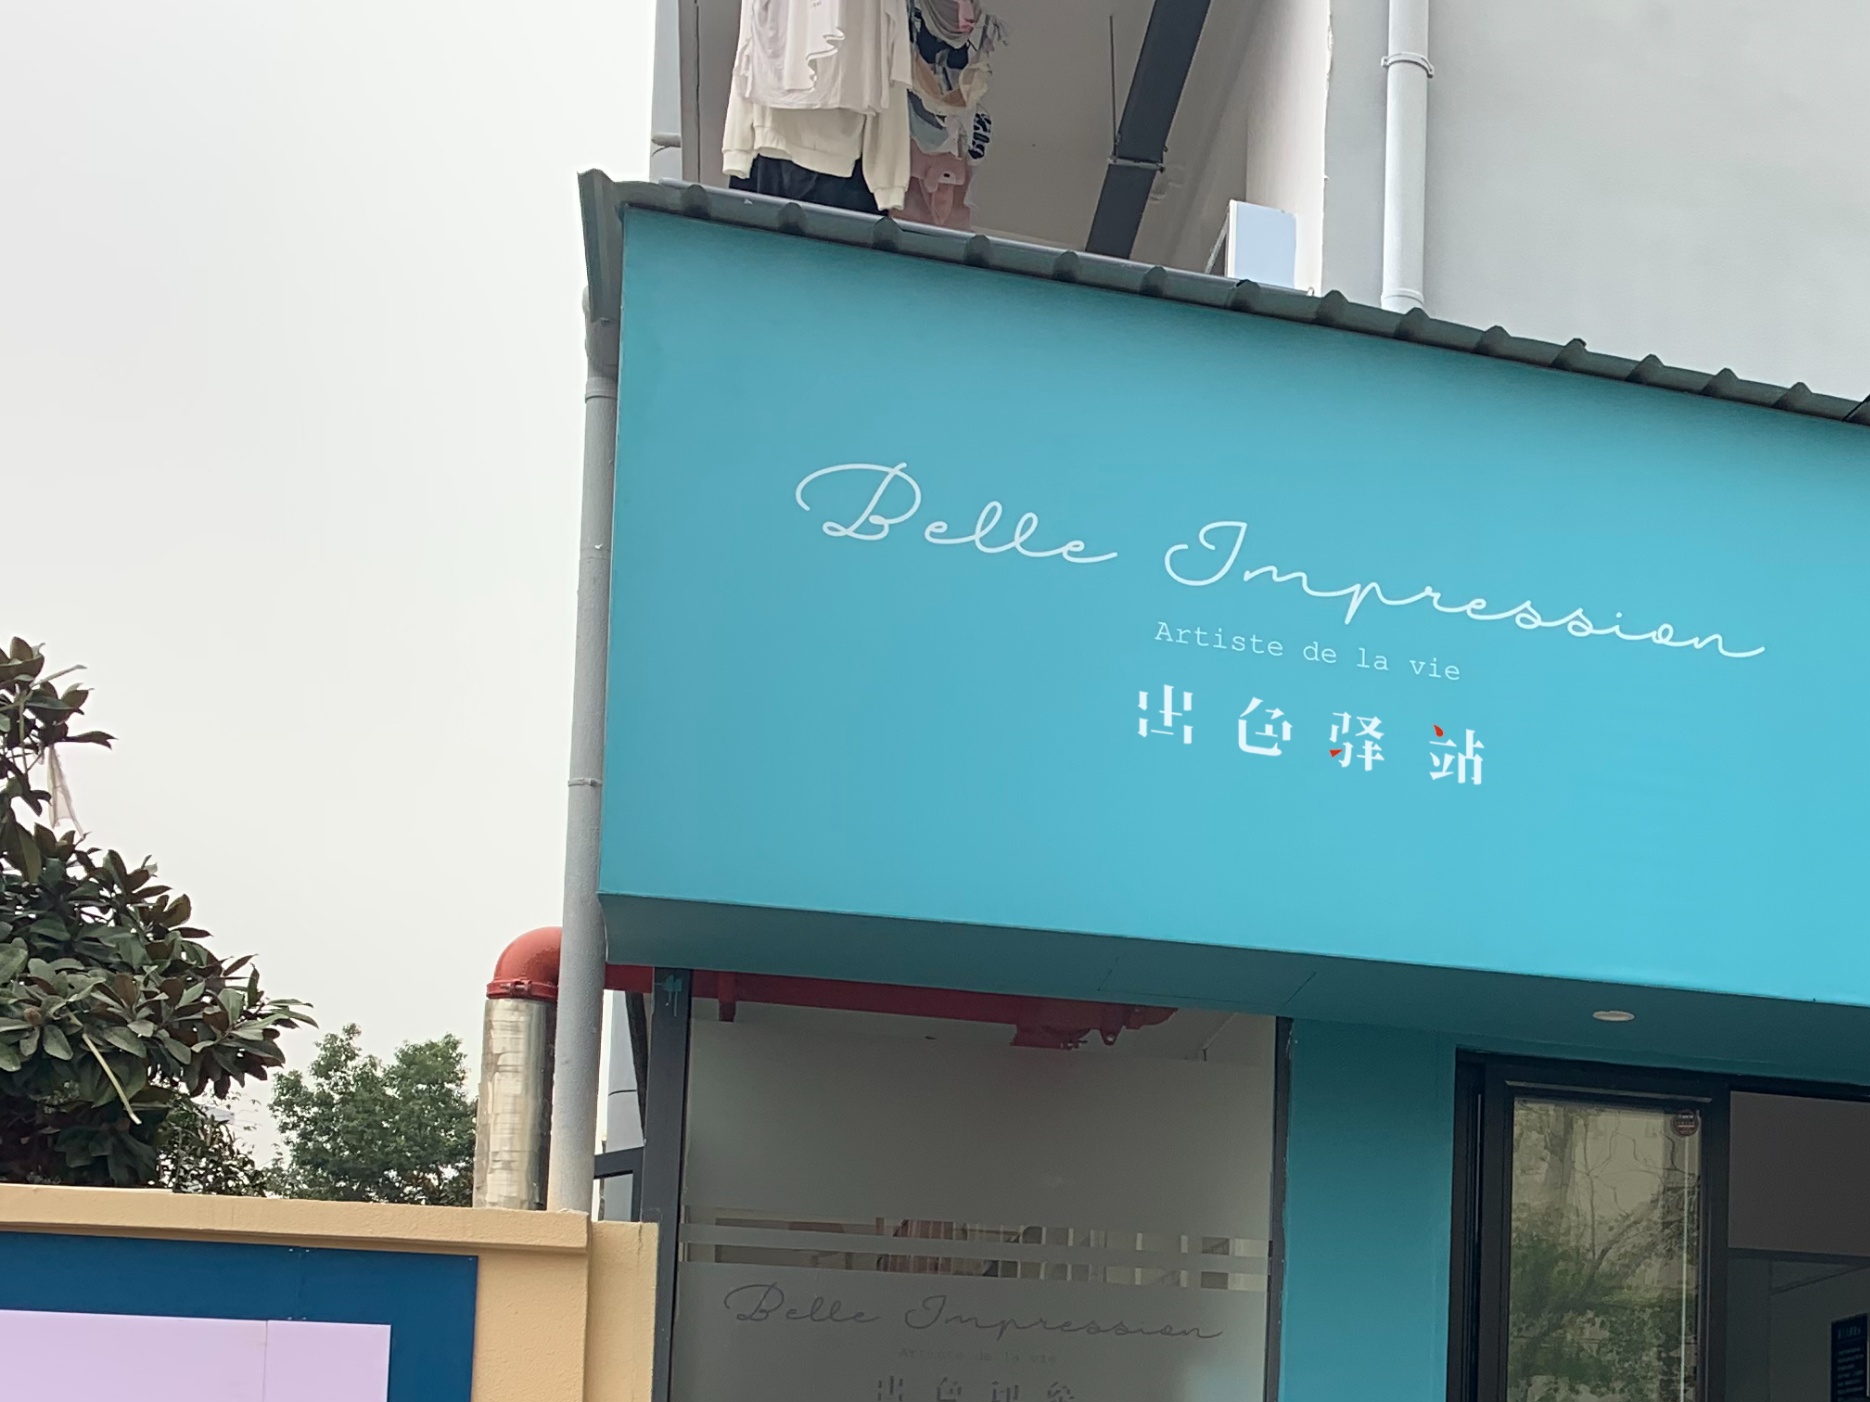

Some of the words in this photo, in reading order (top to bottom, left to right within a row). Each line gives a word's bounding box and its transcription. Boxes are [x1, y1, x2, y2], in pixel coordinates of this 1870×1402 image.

[795, 462, 1119, 564] Belle
[1163, 520, 1766, 659] Impression
[1154, 620, 1284, 657] Artiste
[1302, 640, 1337, 664] de
[1356, 647, 1389, 671] la
[1409, 656, 1461, 682] vie
[1137, 684, 1484, 786] 出色驿站
[723, 1282, 882, 1323] Belle
[904, 1295, 1224, 1342] Impression
